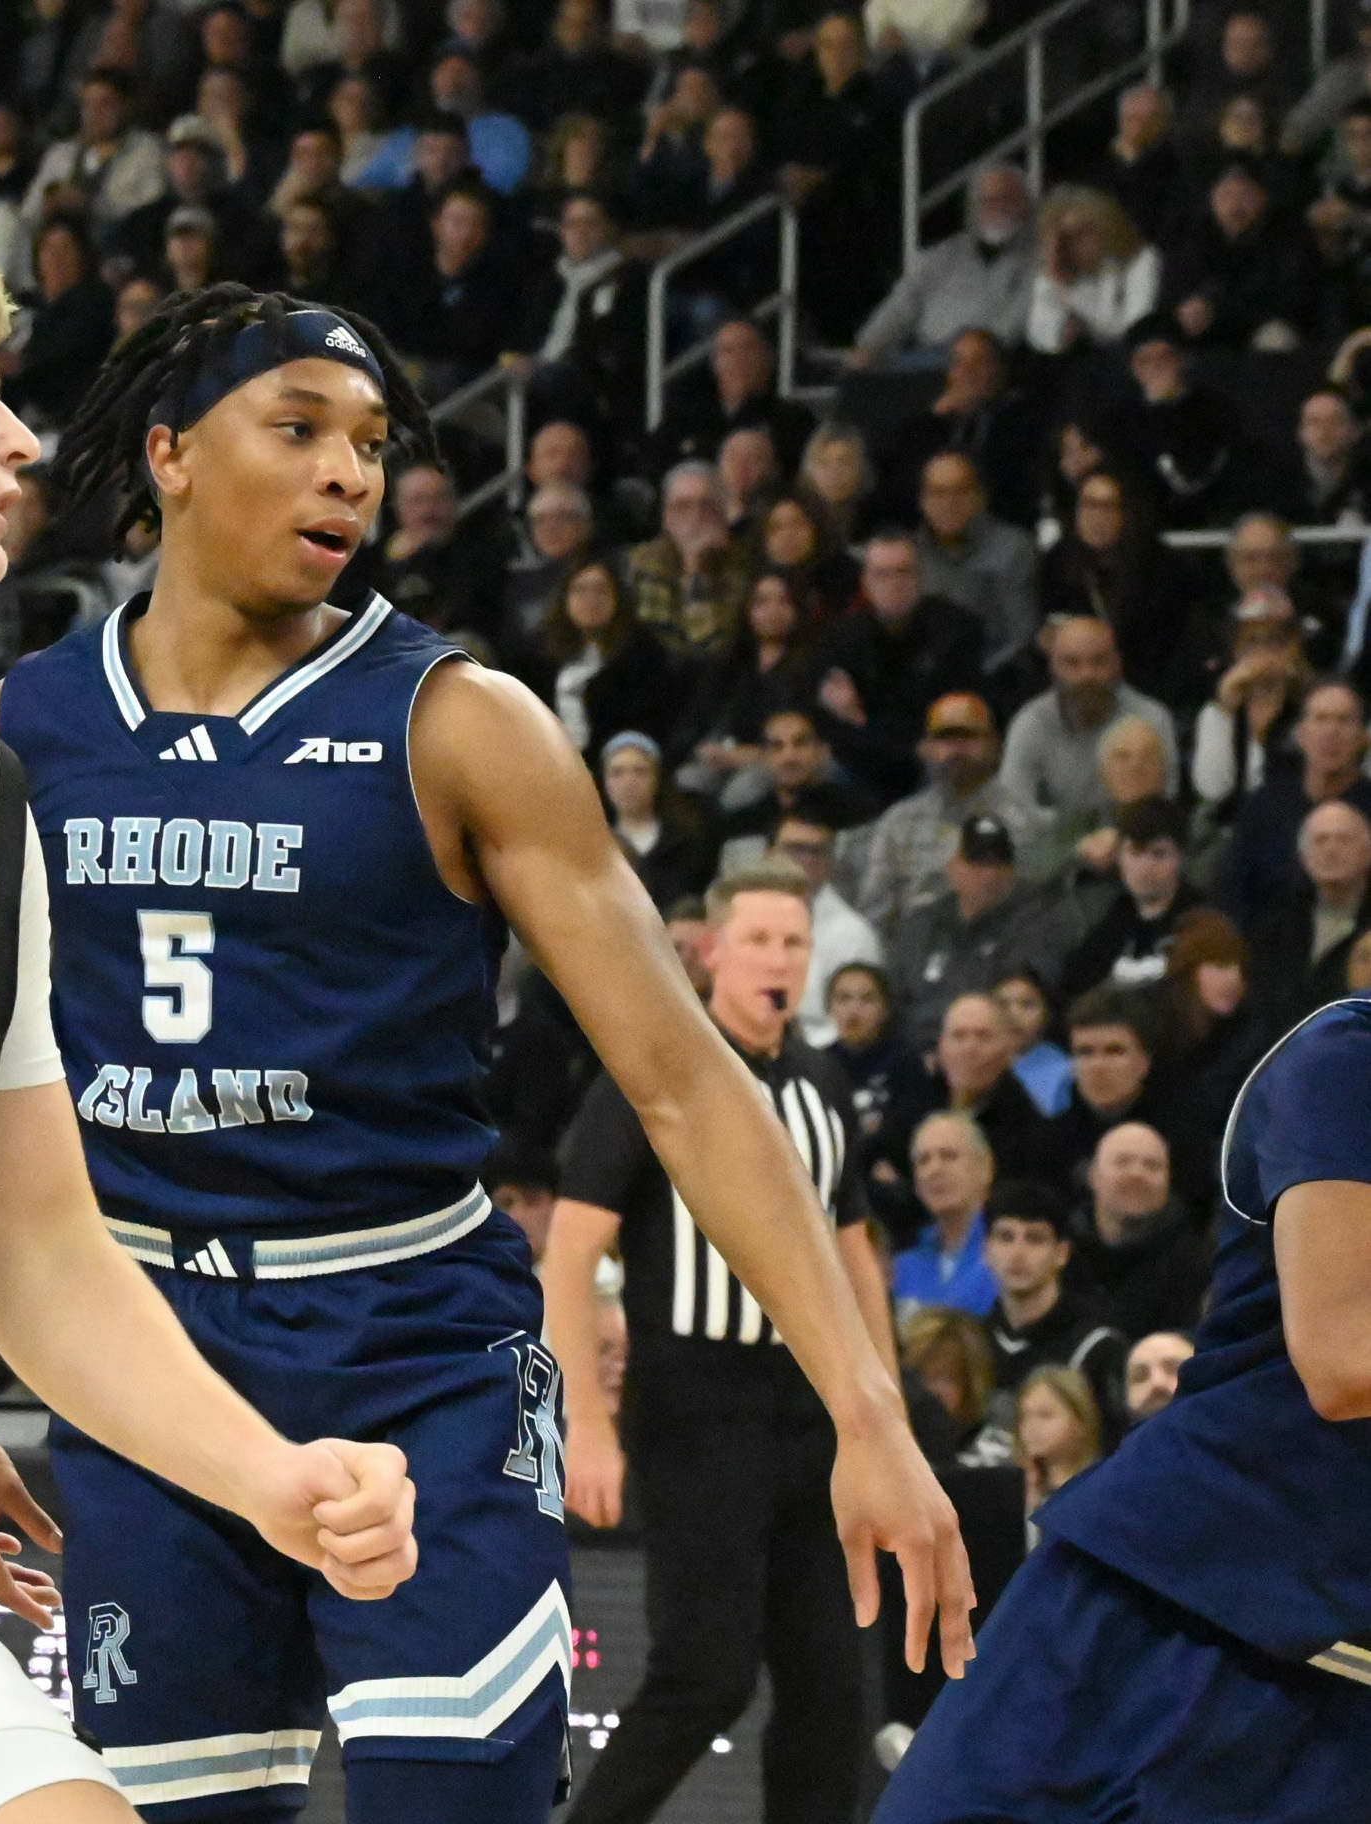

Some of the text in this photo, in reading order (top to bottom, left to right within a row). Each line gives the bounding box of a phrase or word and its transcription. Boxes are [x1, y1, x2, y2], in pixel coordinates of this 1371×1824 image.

[324, 337, 367, 358] adidas
[283, 737, 383, 765] A10
[63, 816, 304, 893] RHODE
[137, 908, 216, 1045] 5
[77, 1063, 315, 1135] ISLAND
